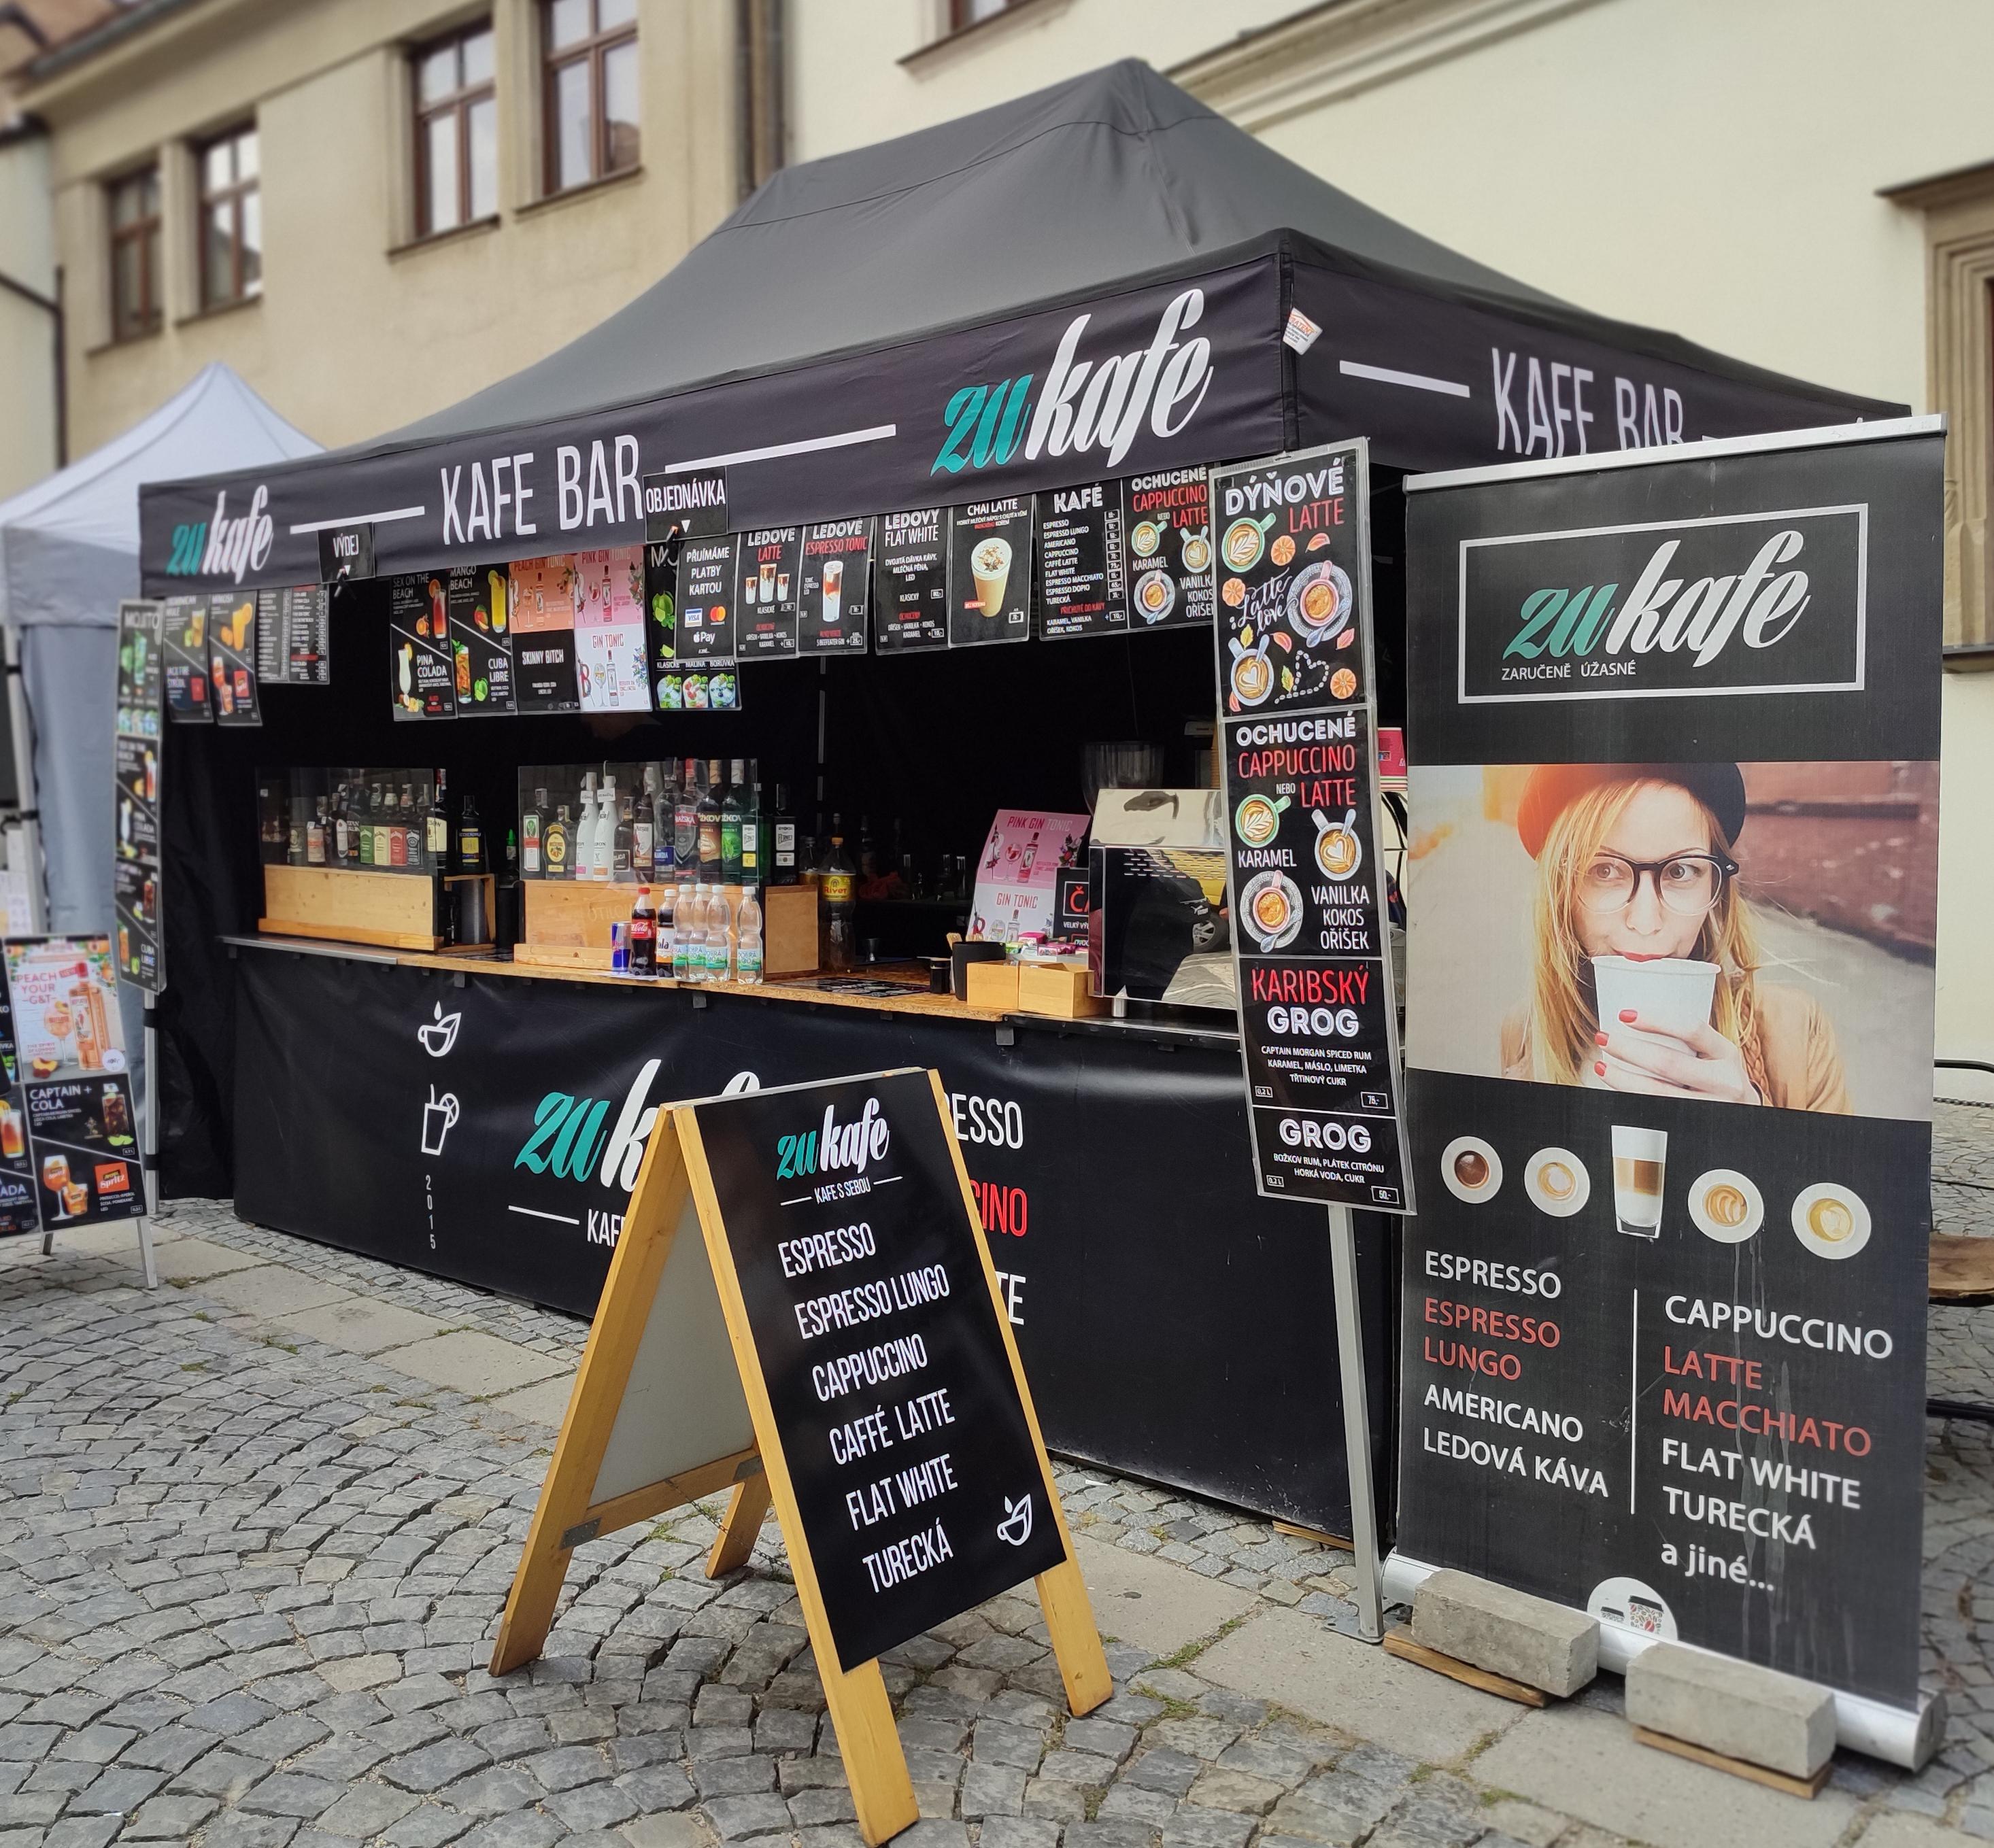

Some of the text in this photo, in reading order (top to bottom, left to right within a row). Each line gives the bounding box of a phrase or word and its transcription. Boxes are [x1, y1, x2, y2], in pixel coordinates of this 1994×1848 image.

[1614, 375, 1685, 451] BAR
[1131, 464, 1207, 492] OCHUCENÉ
[1225, 457, 1345, 517] DÝŇOVÉ
[441, 434, 644, 545] KAFE BAR
[645, 477, 726, 514] OBJEDNÁVKA
[1053, 483, 1103, 513] KAFÉ
[1133, 484, 1207, 513] CAPPUCCINO
[967, 498, 1018, 516] CHAI LATTE
[1172, 506, 1209, 528] LATTE
[1289, 497, 1346, 534] LATTE
[1043, 519, 1069, 529] ESPRESSO
[1043, 526, 1089, 539] ESPRESSO LUNGO
[333, 533, 358, 558] VÝDEJ
[805, 536, 868, 555] ESPRESSO TONIC
[885, 525, 939, 547] FLAT WHITE
[1045, 538, 1076, 549] AMERICANO
[582, 551, 596, 564] PINK
[598, 549, 609, 562] GIN
[686, 546, 730, 563] PŘIJÍMÁME
[758, 545, 782, 562] LATTE
[906, 555, 922, 563] DÁVKA
[1045, 547, 1079, 558] CAPPUCCINO
[1062, 558, 1078, 566] LATTE
[450, 566, 477, 577] MANGO
[691, 564, 722, 579] PLATBY
[1058, 567, 1075, 576] WHITE
[1132, 555, 1169, 572] KARAMEL
[393, 573, 429, 587] SEX ON THE
[450, 578, 473, 590] BEACH
[905, 574, 915, 582] LED
[1045, 572, 1104, 586] ESPRESSO MACCHIATO
[393, 587, 413, 599] BEACH
[690, 581, 722, 596] KARTOU
[1046, 584, 1090, 596] ESPRESSO DOPIO
[1236, 567, 1293, 628] Latte
[1256, 597, 1299, 636] love
[592, 633, 624, 649] GIN TONIC
[700, 631, 715, 645] Pay
[488, 657, 508, 669] CUBA
[522, 649, 564, 665] SKINNY BITCH
[418, 665, 447, 677] COLADA
[490, 671, 509, 683] LIBRE
[1501, 660, 1637, 681] ZARUČENĚ ÚŽASNÉ
[1236, 711, 1357, 747] OCHUCENÉ
[1238, 744, 1356, 779] CAPPUCCINO
[1276, 778, 1357, 808] NEBO LATTE
[1007, 816, 1073, 832] PINK GIN TONIC
[1238, 849, 1298, 868] KARAMEL
[824, 886, 847, 894] River
[996, 892, 1038, 908] GIN TONIC
[1311, 885, 1370, 906] VANILKA
[1323, 909, 1365, 927] KOKOS
[1321, 927, 1370, 951] OŘÍŠEK
[16, 973, 56, 983] PEACH
[1251, 964, 1370, 1005] KARIBSKÝ
[22, 984, 55, 994] YOUR
[1266, 1006, 1359, 1038] GROG
[1261, 1046, 1372, 1061] CAPTAIN MORGAN SPICED RUM
[1268, 1059, 1367, 1074] KARAMEL, MÁSLO, LIMETKA
[1289, 1073, 1347, 1086] TŘTINOVÝ CUKR
[30, 1084, 81, 1100] CAPTAIN
[31, 1099, 64, 1112] COLA
[944, 1093, 1024, 1149] ESSO
[1279, 1118, 1372, 1153] GROG
[1273, 1153, 1302, 1164] BOŽKOV
[1323, 1158, 1351, 1169] PLÁTEK
[1351, 1162, 1384, 1173] CITRÓNU
[1294, 1167, 1319, 1178] HORKÁ
[1345, 1174, 1366, 1183] CUKR
[814, 1176, 871, 1204] KAFE S SEBOU
[587, 1208, 626, 1247] KAF
[777, 1222, 877, 1278] ESPRESSO
[1425, 1250, 1561, 1299] ESPRESSO
[794, 1264, 951, 1340] ESPRESSO LUNGO
[1425, 1297, 1561, 1348] ESPRESSO
[1664, 1295, 1893, 1360] CAPPUCCINO
[812, 1333, 928, 1402] CAPPUCCINO
[1424, 1336, 1522, 1381] LUNGO
[1664, 1346, 1763, 1390] LATTE
[1423, 1384, 1583, 1443] AMERICANO
[1663, 1388, 1872, 1457] MACCHIATO
[829, 1388, 956, 1466] CAFFÉ LATTE
[1423, 1426, 1609, 1498] LEDOVÁ KÁVA
[1662, 1438, 1861, 1510] FLAT WHITE
[845, 1453, 958, 1531] FLAT WHITE
[1662, 1485, 1816, 1550] TURECKÁ
[862, 1517, 953, 1594] TURECKÁ
[1661, 1543, 1678, 1566] a
